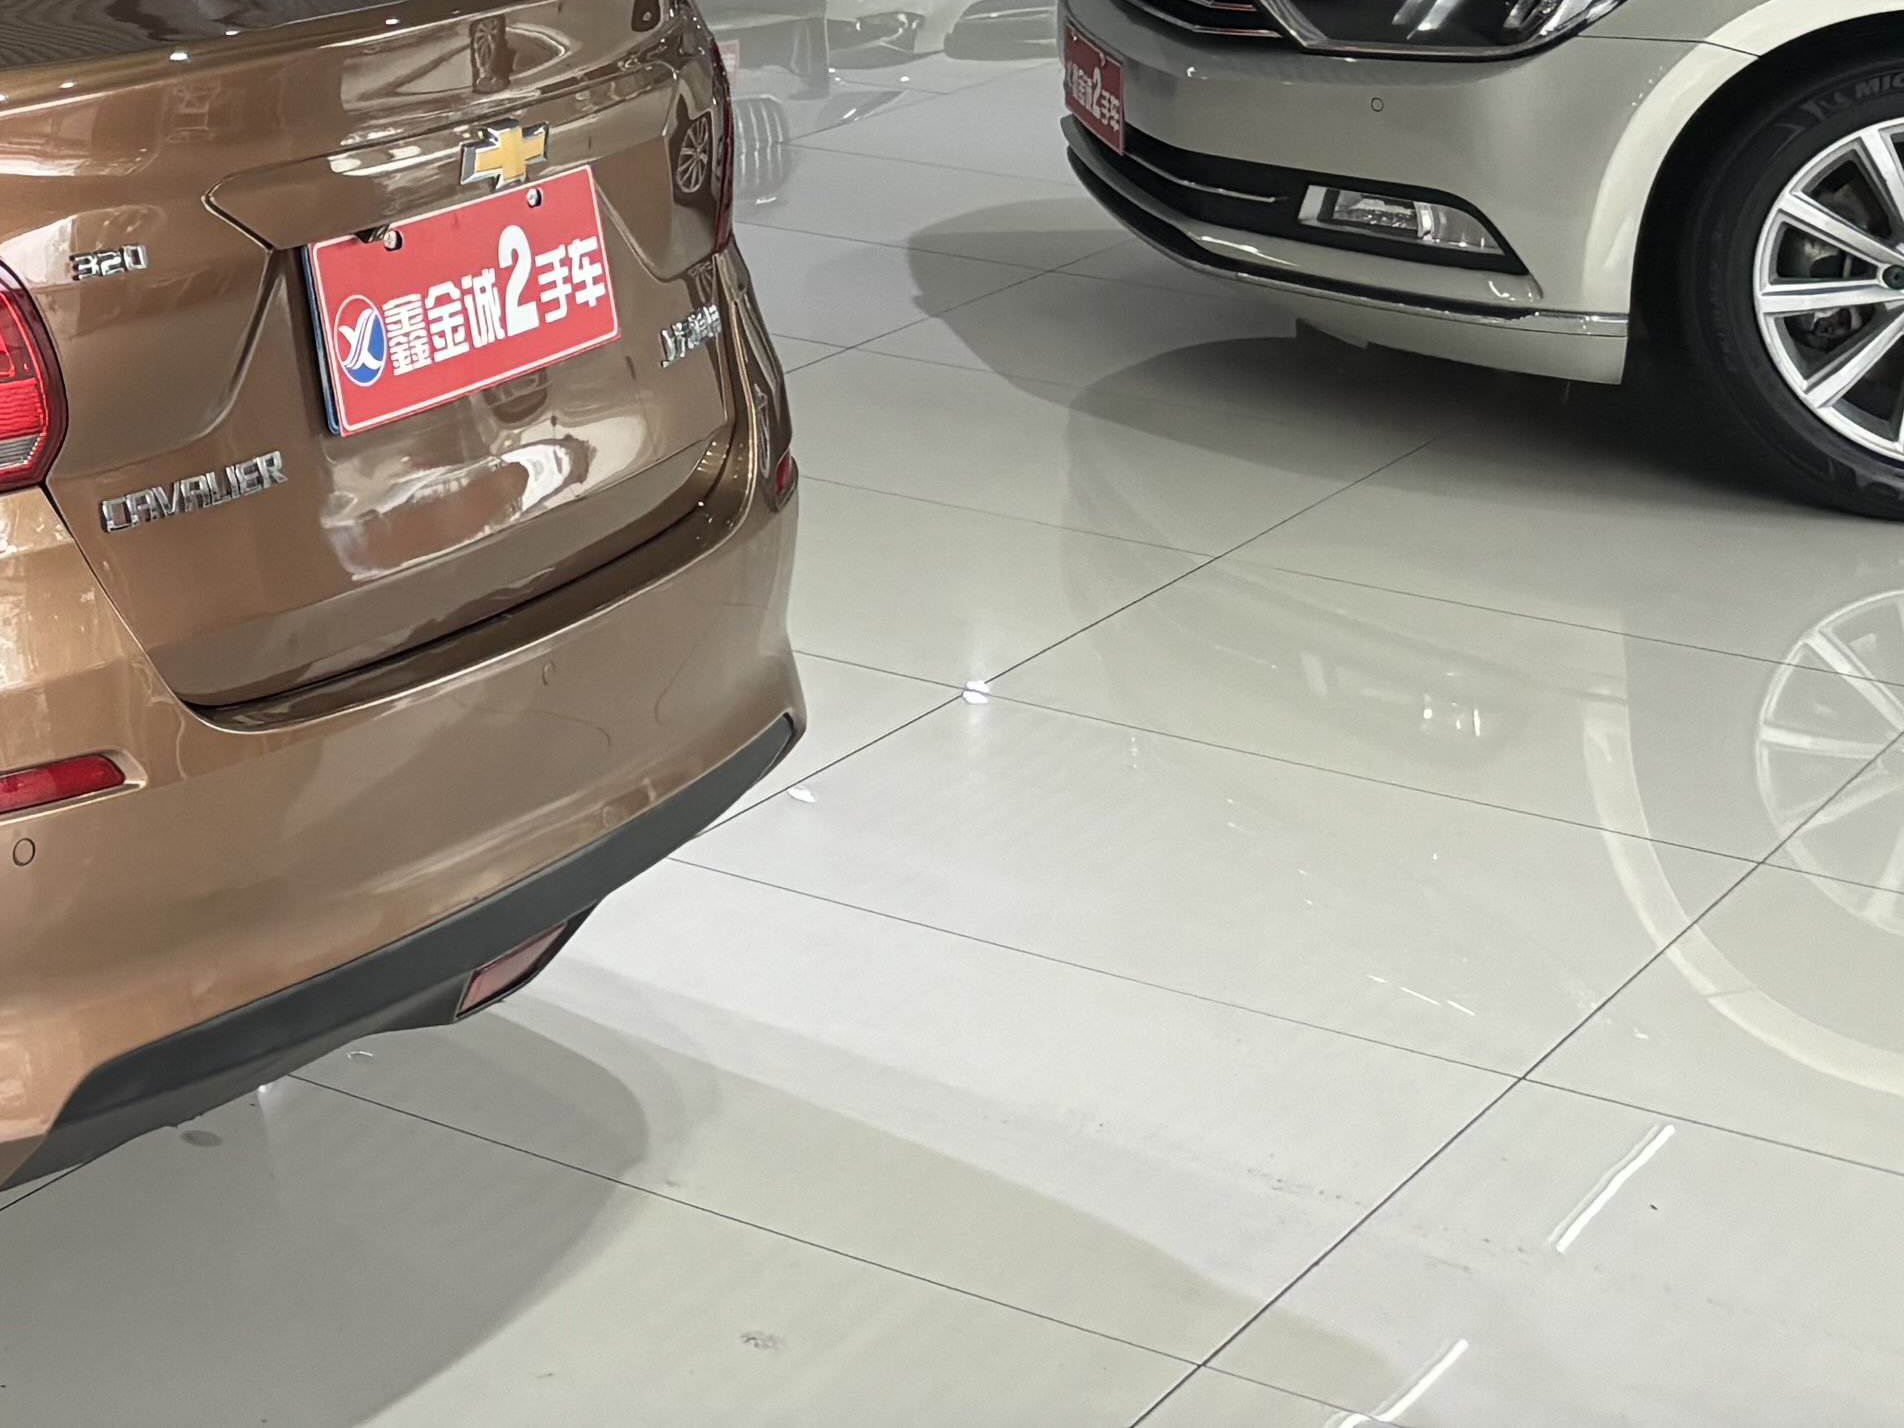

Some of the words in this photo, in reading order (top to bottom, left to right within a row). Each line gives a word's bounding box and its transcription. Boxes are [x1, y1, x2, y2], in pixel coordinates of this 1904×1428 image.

[68, 242, 149, 283] 320
[382, 223, 606, 378] 鑫金诚2手车
[99, 449, 289, 535] CAVALIER
